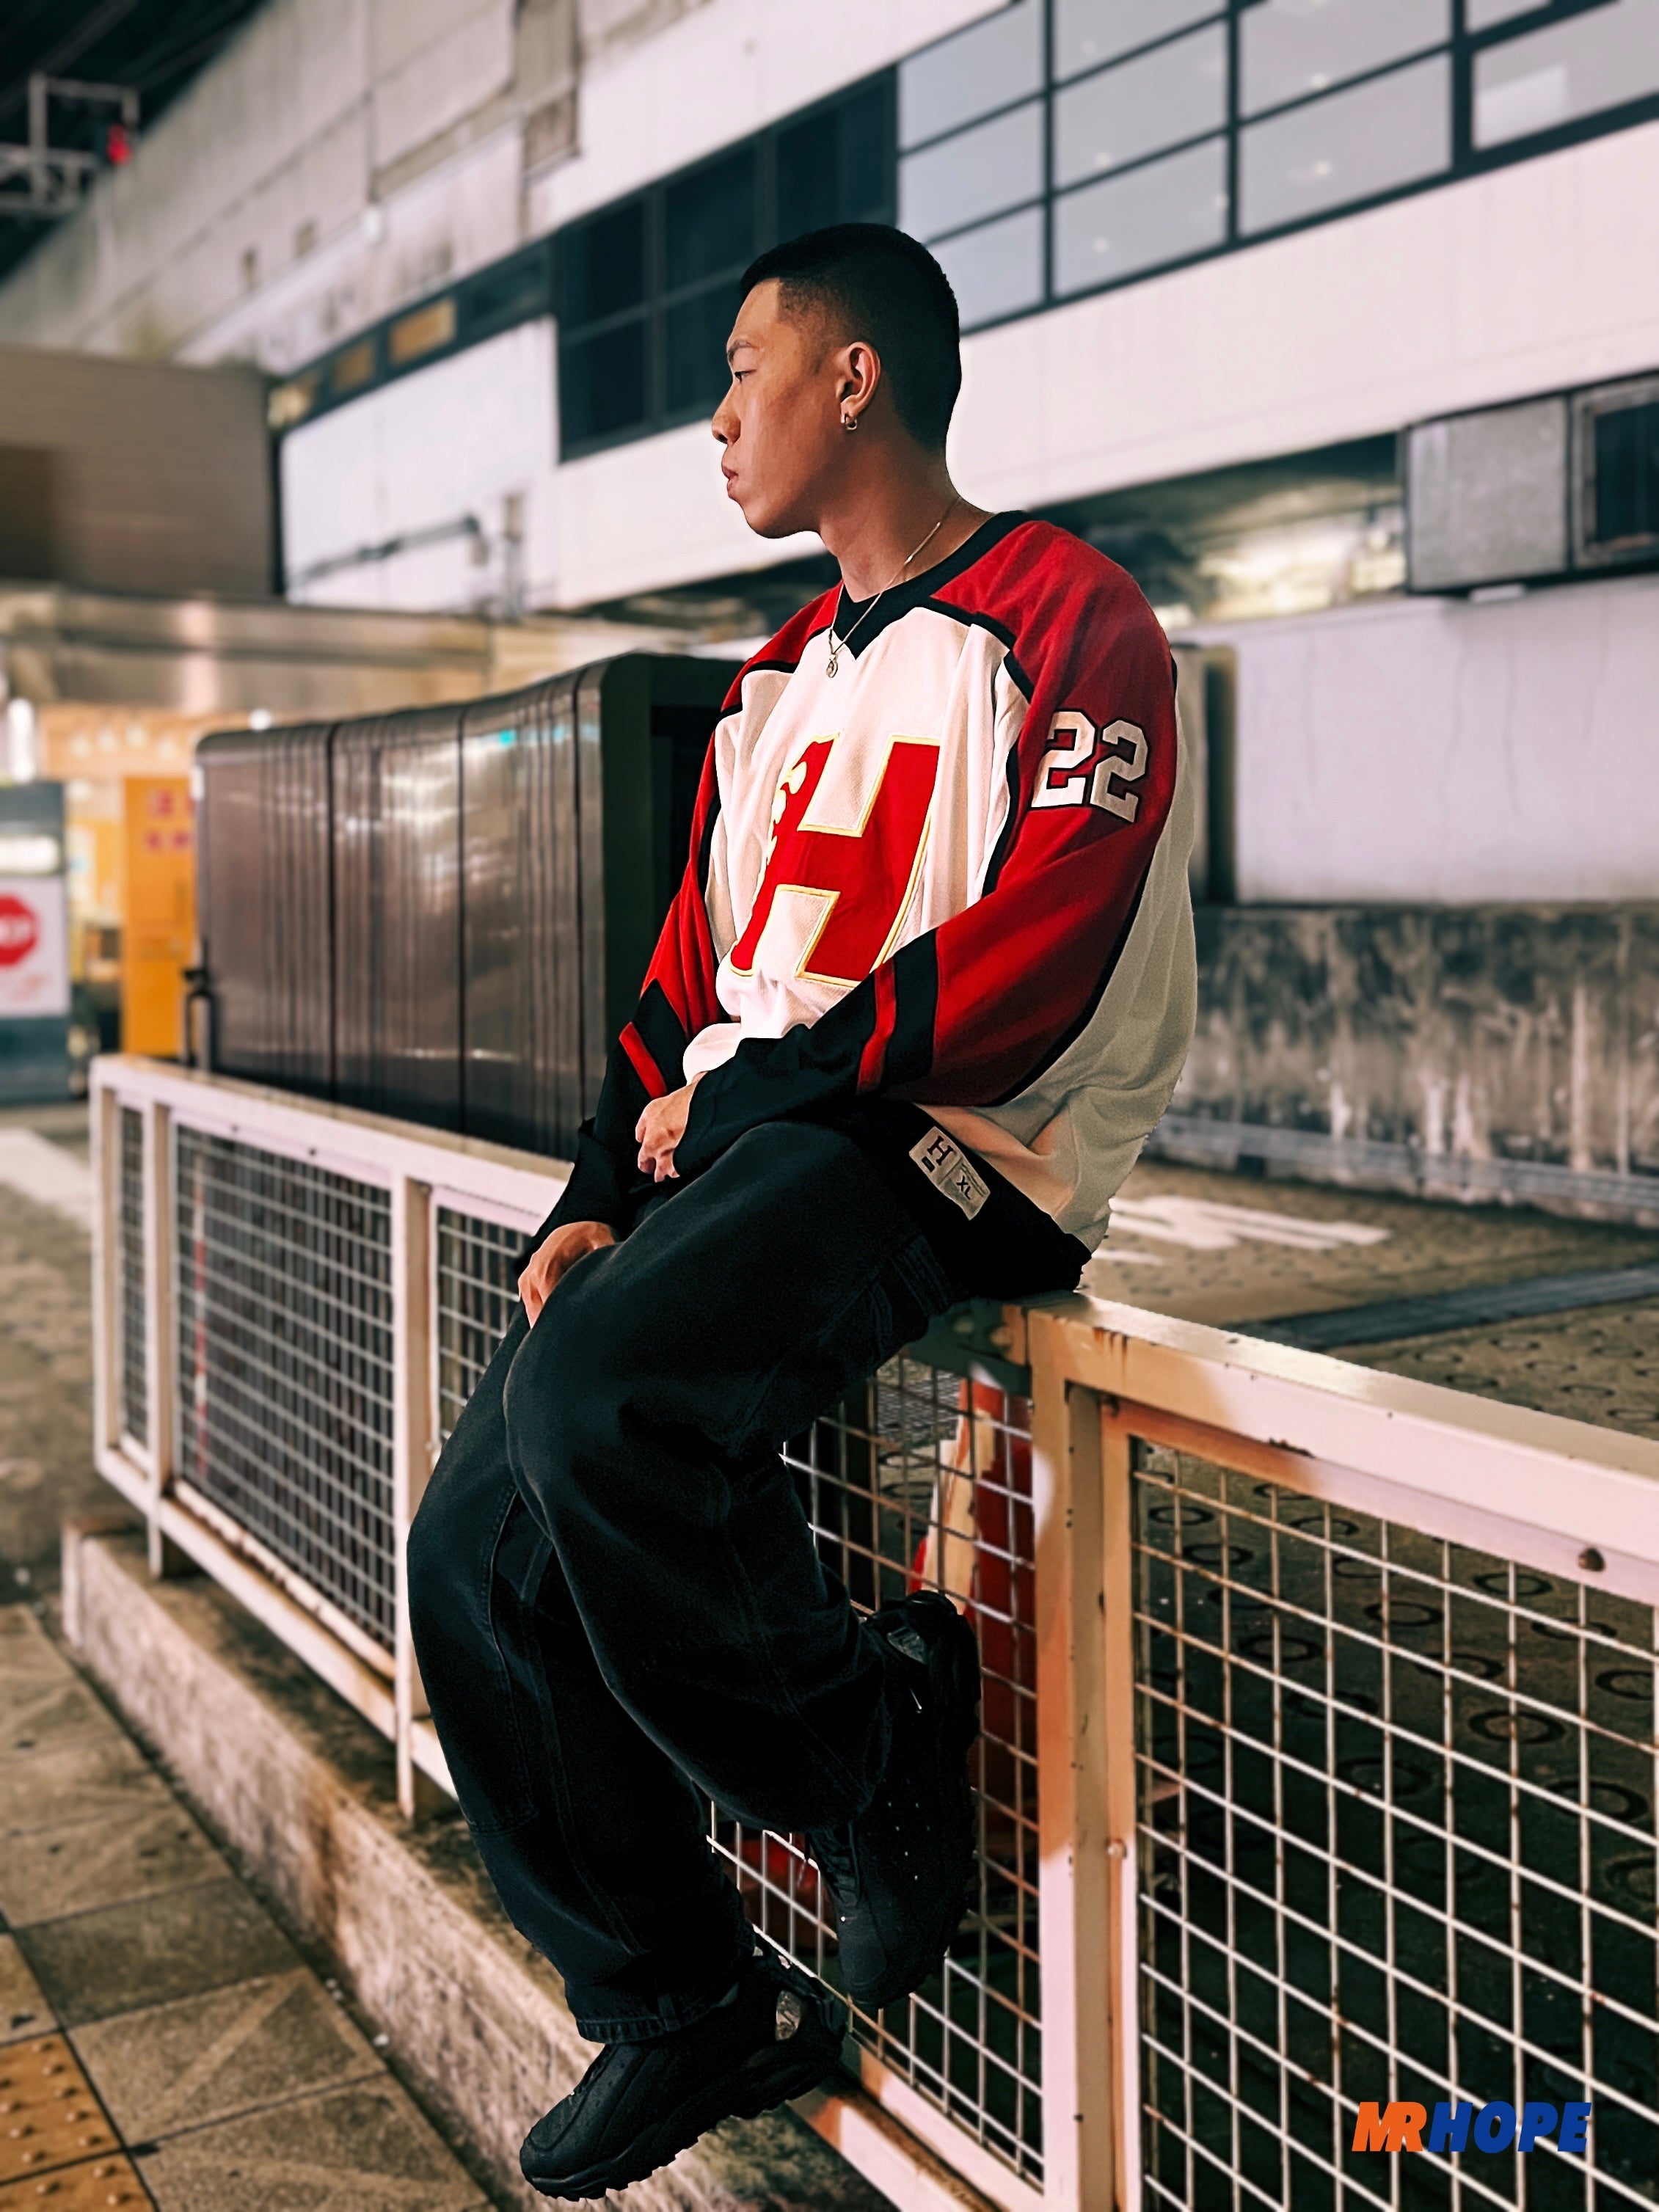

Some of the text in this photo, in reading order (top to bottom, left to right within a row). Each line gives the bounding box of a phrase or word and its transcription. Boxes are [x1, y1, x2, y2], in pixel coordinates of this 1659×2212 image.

[1029, 709, 1150, 824] 22
[729, 733, 941, 989] H
[927, 1135, 954, 1166] H
[956, 1175, 971, 1201] XL
